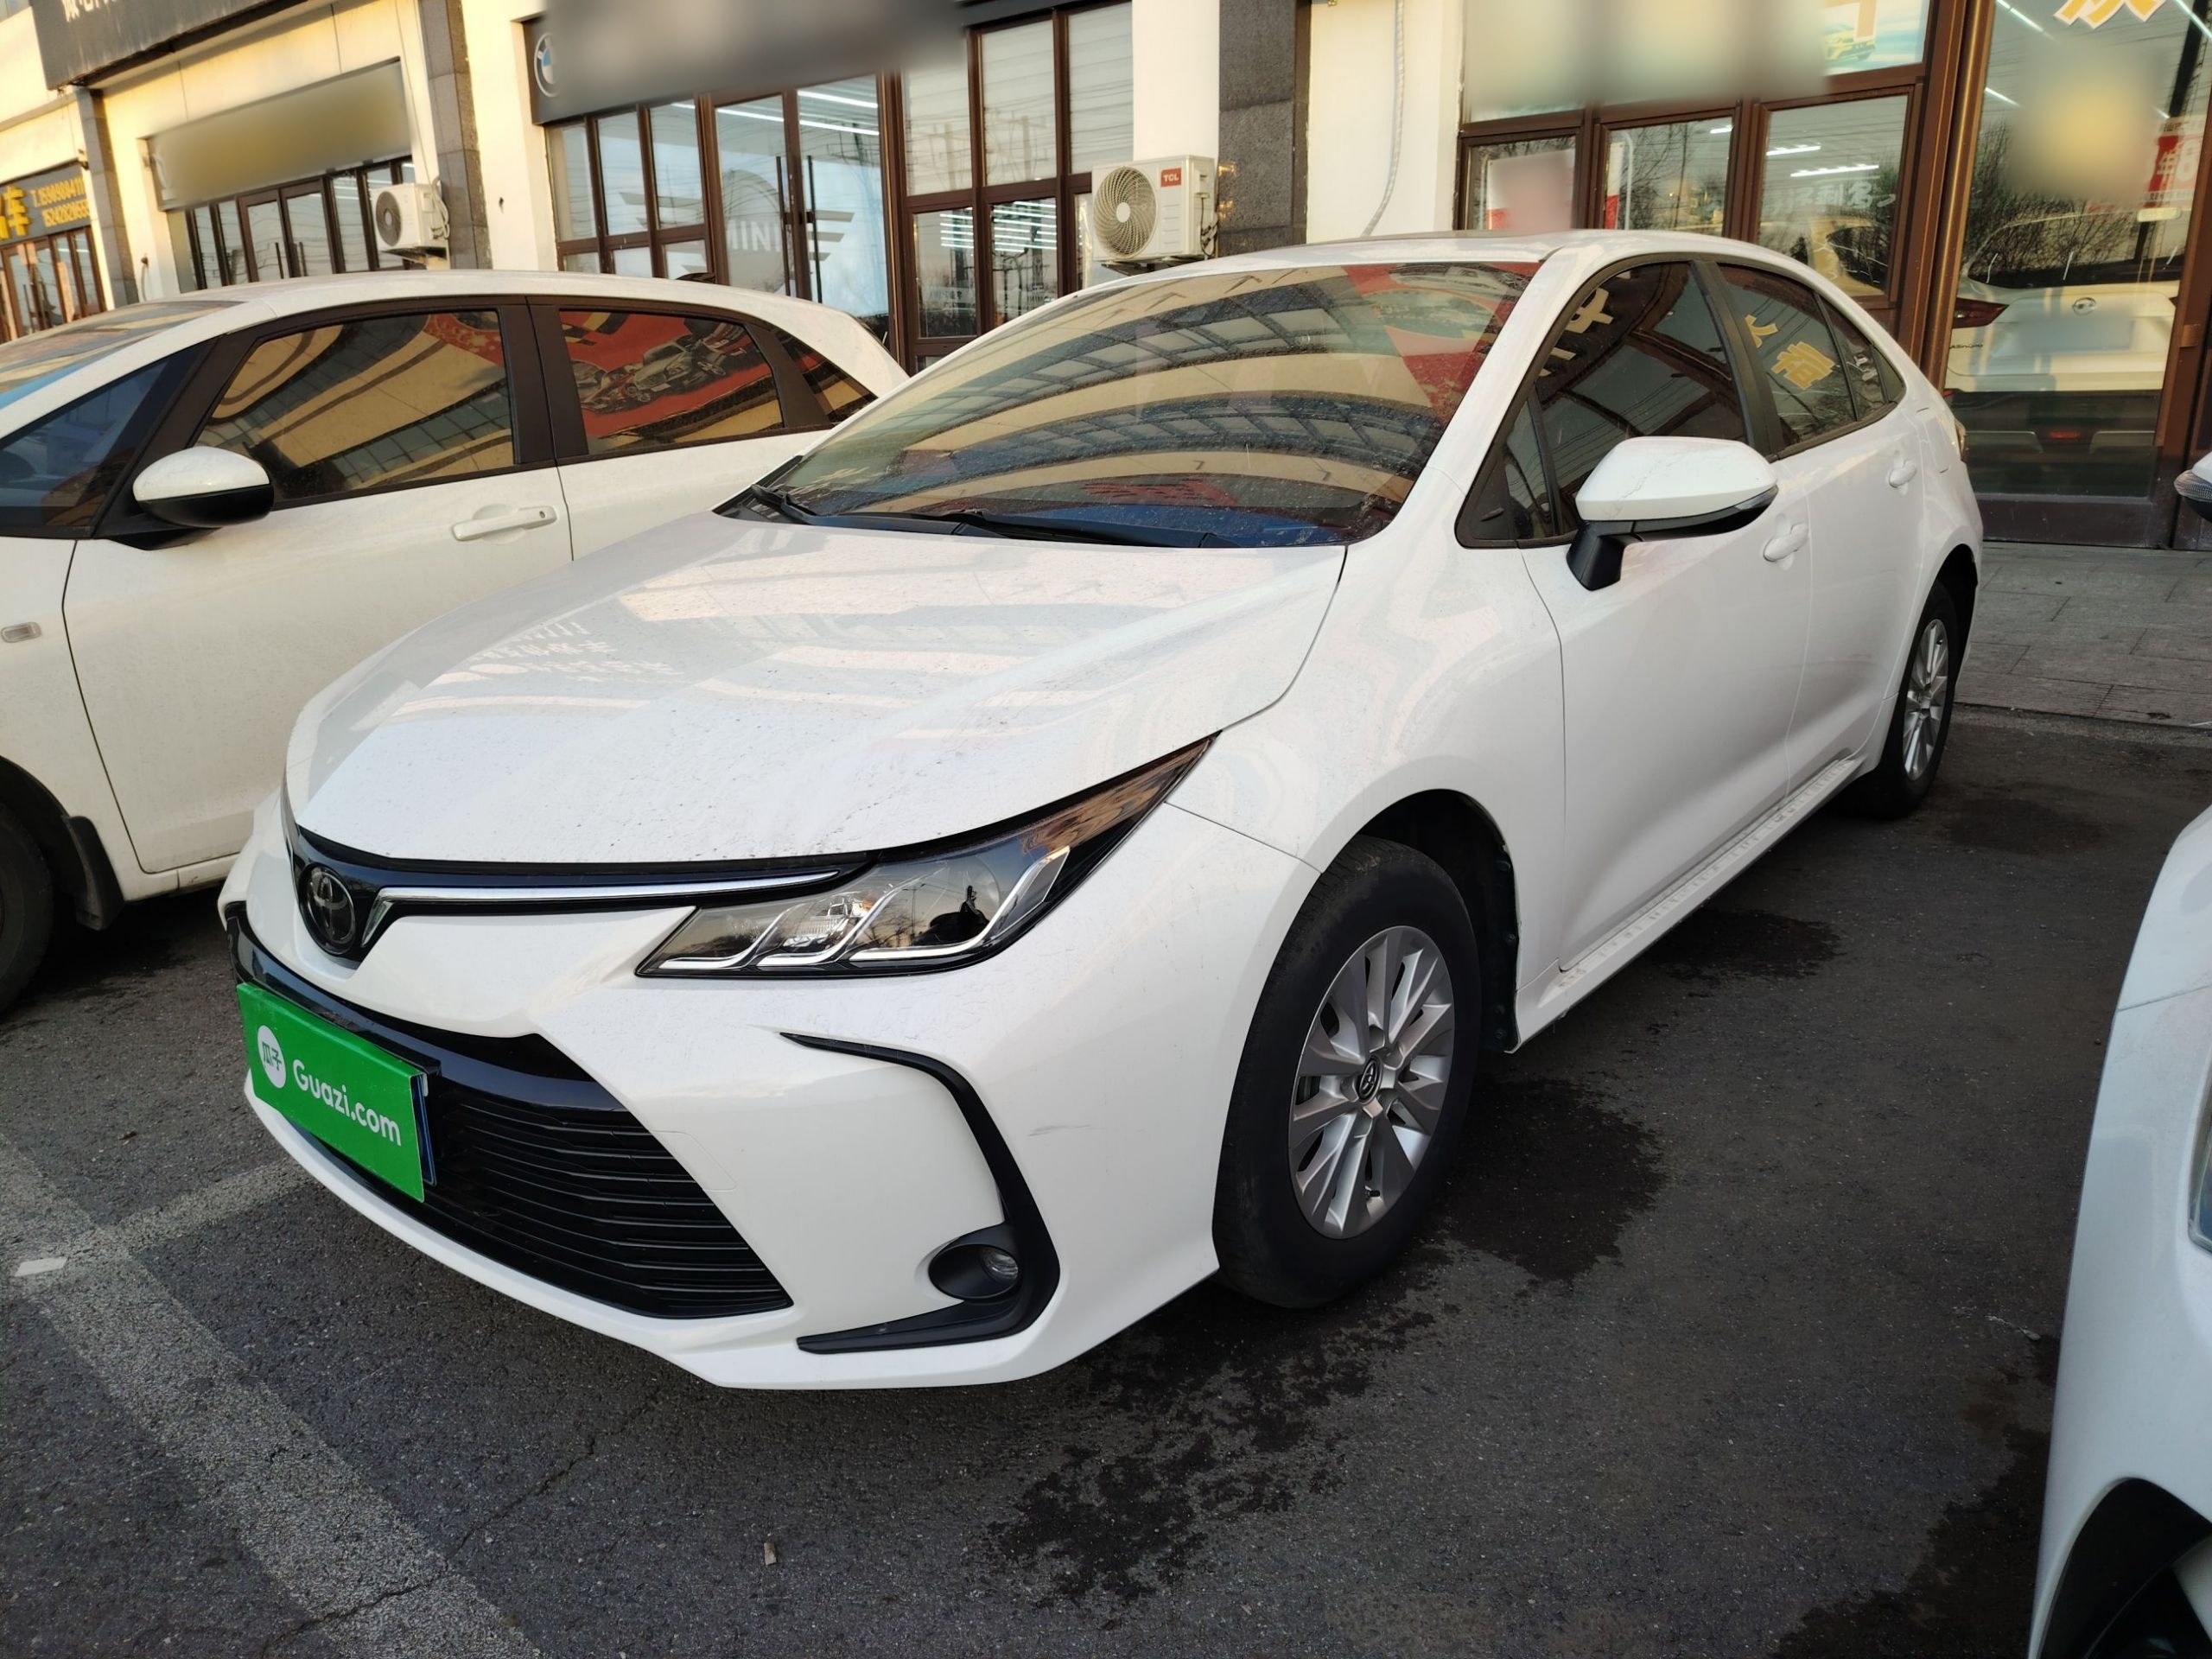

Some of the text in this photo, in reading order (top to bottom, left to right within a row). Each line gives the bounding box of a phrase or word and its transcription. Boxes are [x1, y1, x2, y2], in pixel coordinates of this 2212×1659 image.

[1162, 173, 1179, 182] TCL
[0, 185, 29, 240] 车
[262, 1041, 282, 1071] 瓜子
[293, 1059, 402, 1147] Guazi.com
